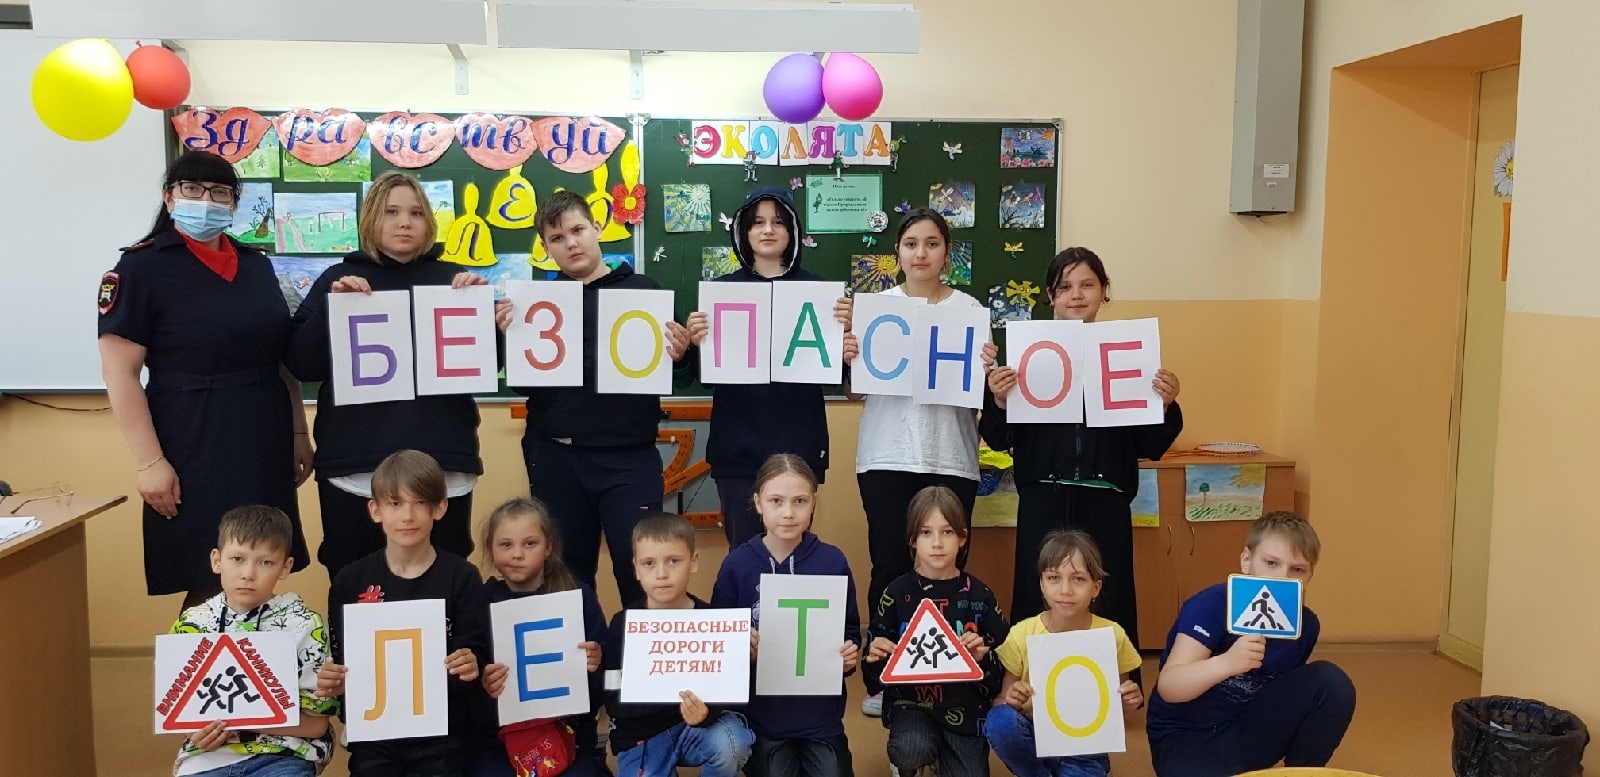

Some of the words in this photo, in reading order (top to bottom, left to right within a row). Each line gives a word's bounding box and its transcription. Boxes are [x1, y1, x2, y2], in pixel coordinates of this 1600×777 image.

[693, 123, 891, 160] ЭКОЛЯТА
[626, 620, 749, 634] БЕЗОПАСНЫЕ
[648, 640, 725, 655] ДОРОГИ
[155, 636, 214, 717] ВНИМАНИЕ
[236, 637, 296, 710] КАНИКУЛЫ
[649, 659, 722, 675] ДЕТЯМ!
